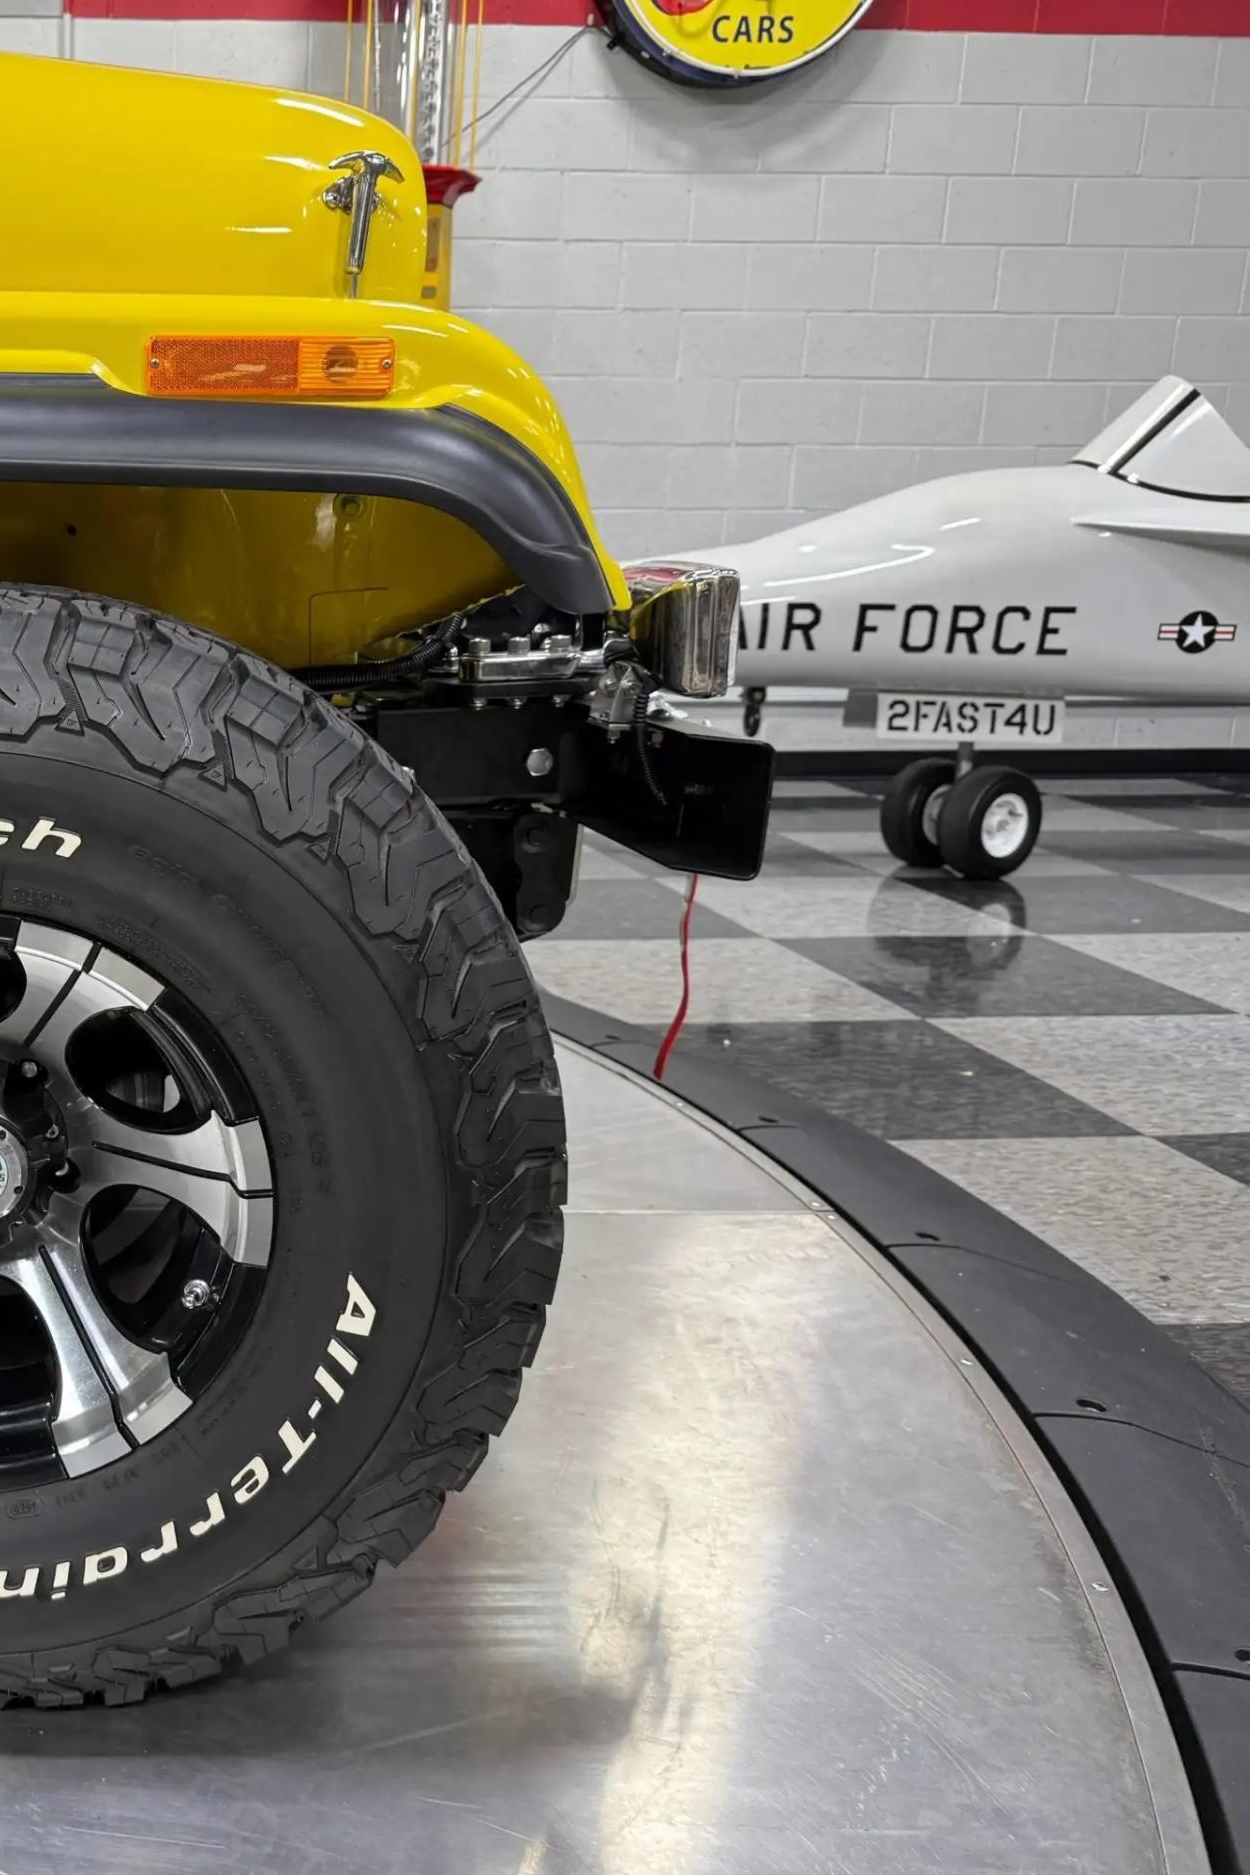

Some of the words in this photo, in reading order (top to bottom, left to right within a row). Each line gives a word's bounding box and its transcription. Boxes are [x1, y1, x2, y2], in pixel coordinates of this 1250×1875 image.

[711, 15, 794, 44] CARS
[852, 602, 1077, 656] FORCE
[887, 699, 1056, 736] 2FAST4U
